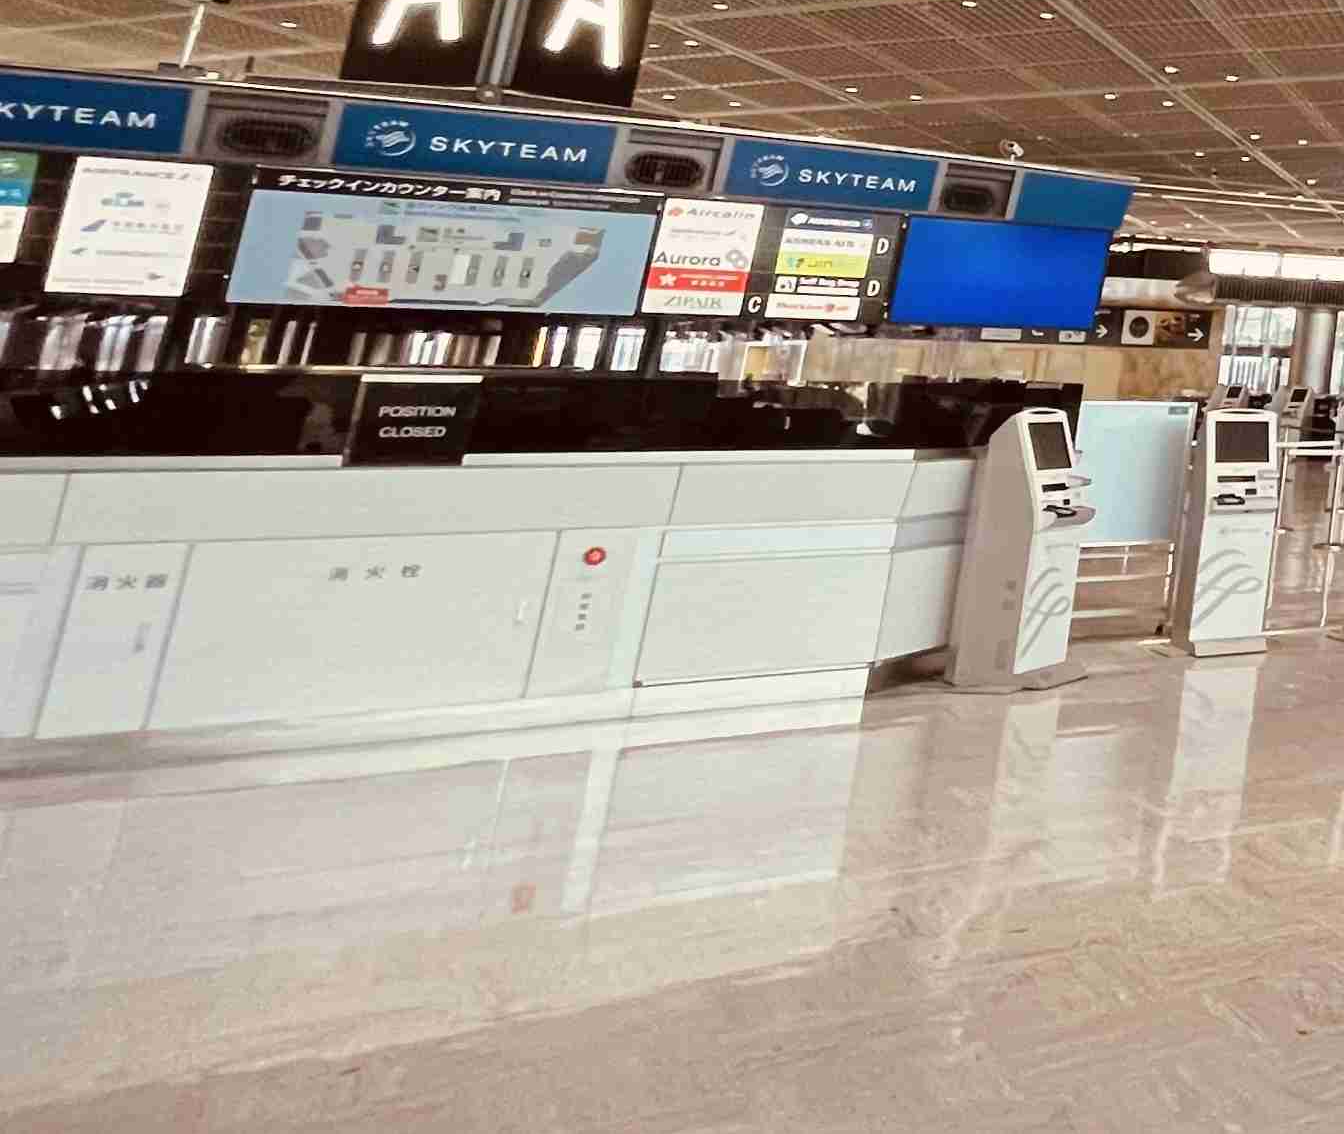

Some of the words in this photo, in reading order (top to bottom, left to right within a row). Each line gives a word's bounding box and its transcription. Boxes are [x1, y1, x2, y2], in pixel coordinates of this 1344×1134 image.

[429, 135, 588, 163] SKYTEAM
[277, 174, 501, 202] チェックインカウンター案内
[798, 168, 918, 193] SKYTEAM
[876, 237, 890, 255] D
[654, 251, 721, 266] Aurora
[866, 279, 881, 297] D
[746, 295, 762, 314] C
[378, 405, 457, 418] POSITION
[378, 426, 447, 438] CLOSED
